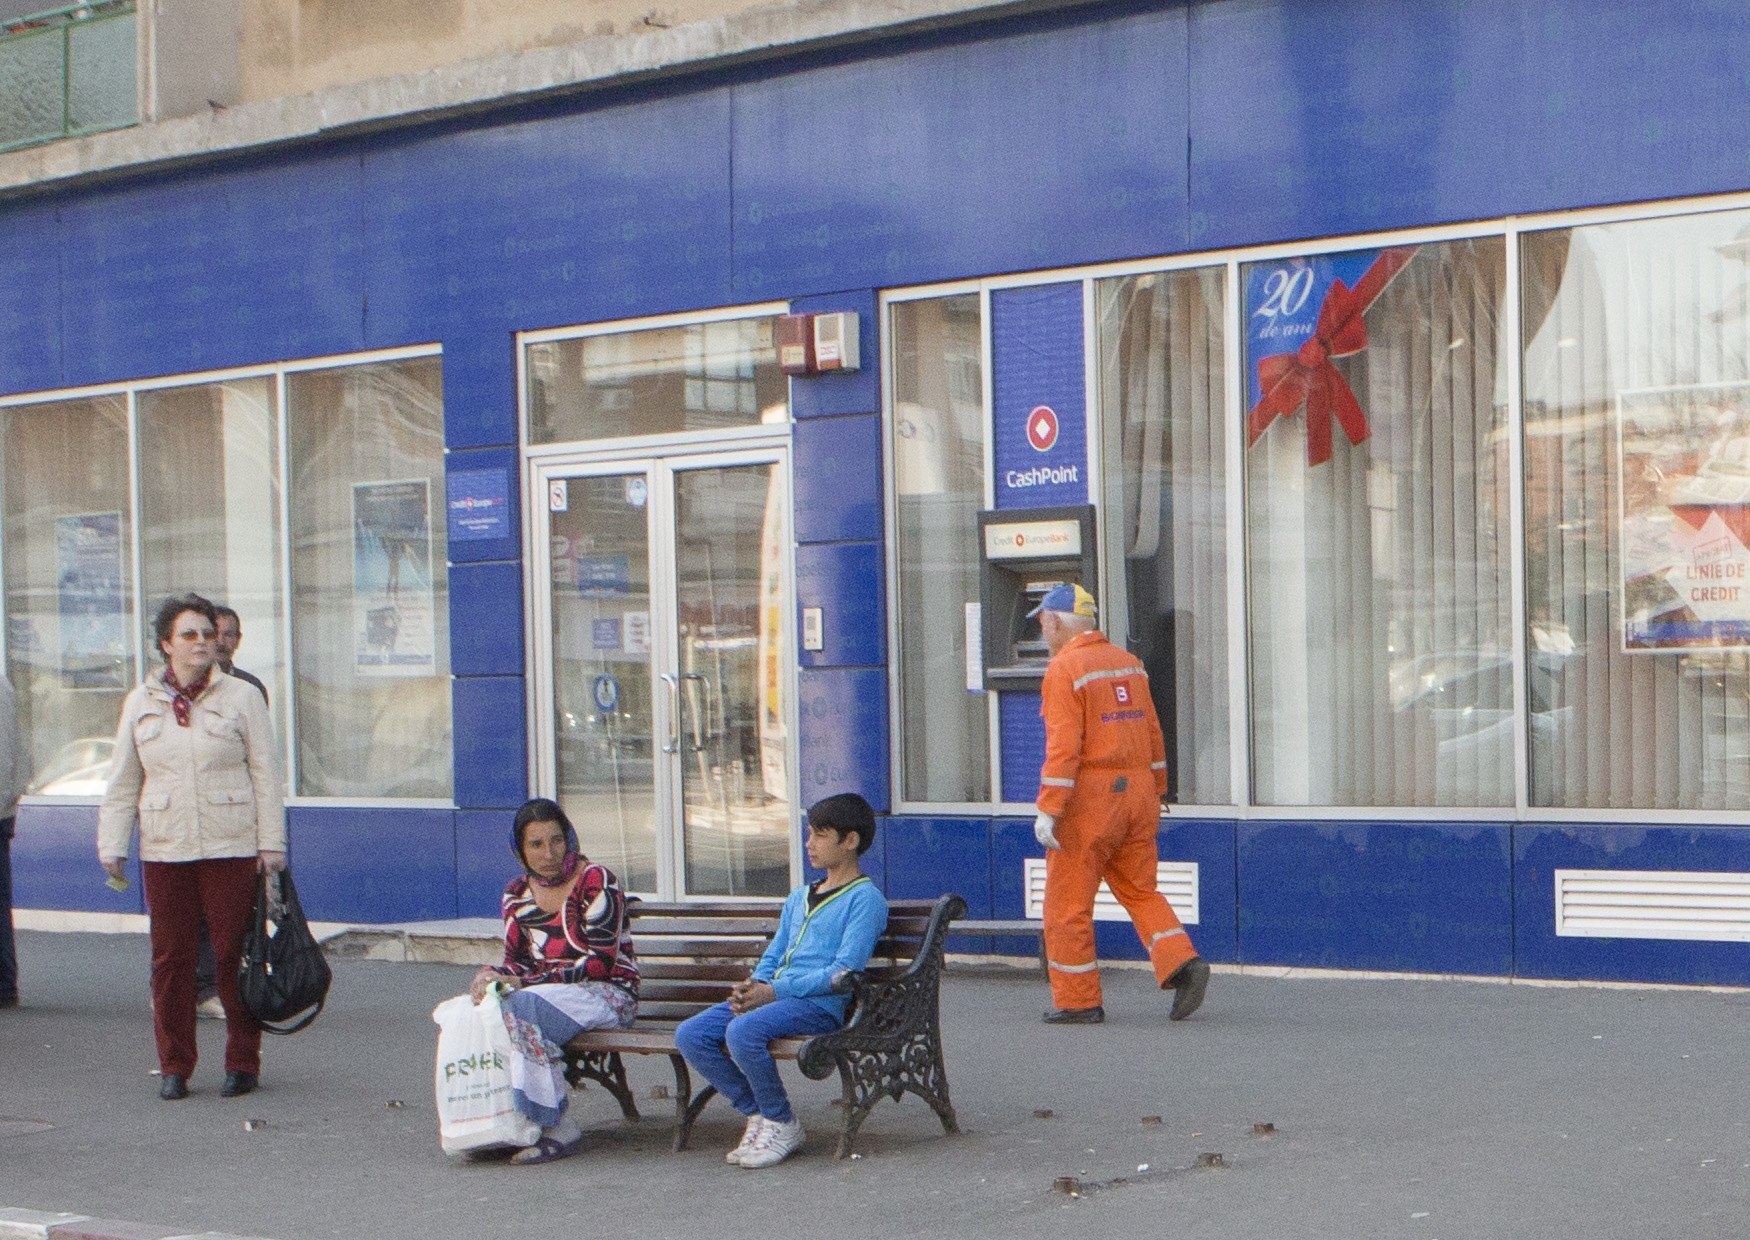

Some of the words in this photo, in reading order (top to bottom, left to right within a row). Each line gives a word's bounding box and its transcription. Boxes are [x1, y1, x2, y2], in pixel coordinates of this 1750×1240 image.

[1252, 267, 1314, 317] 20
[1007, 465, 1078, 488] CashPoint
[1686, 563, 1723, 580] LINIE
[1726, 563, 1745, 578] DE
[1690, 586, 1741, 602] CREDIT
